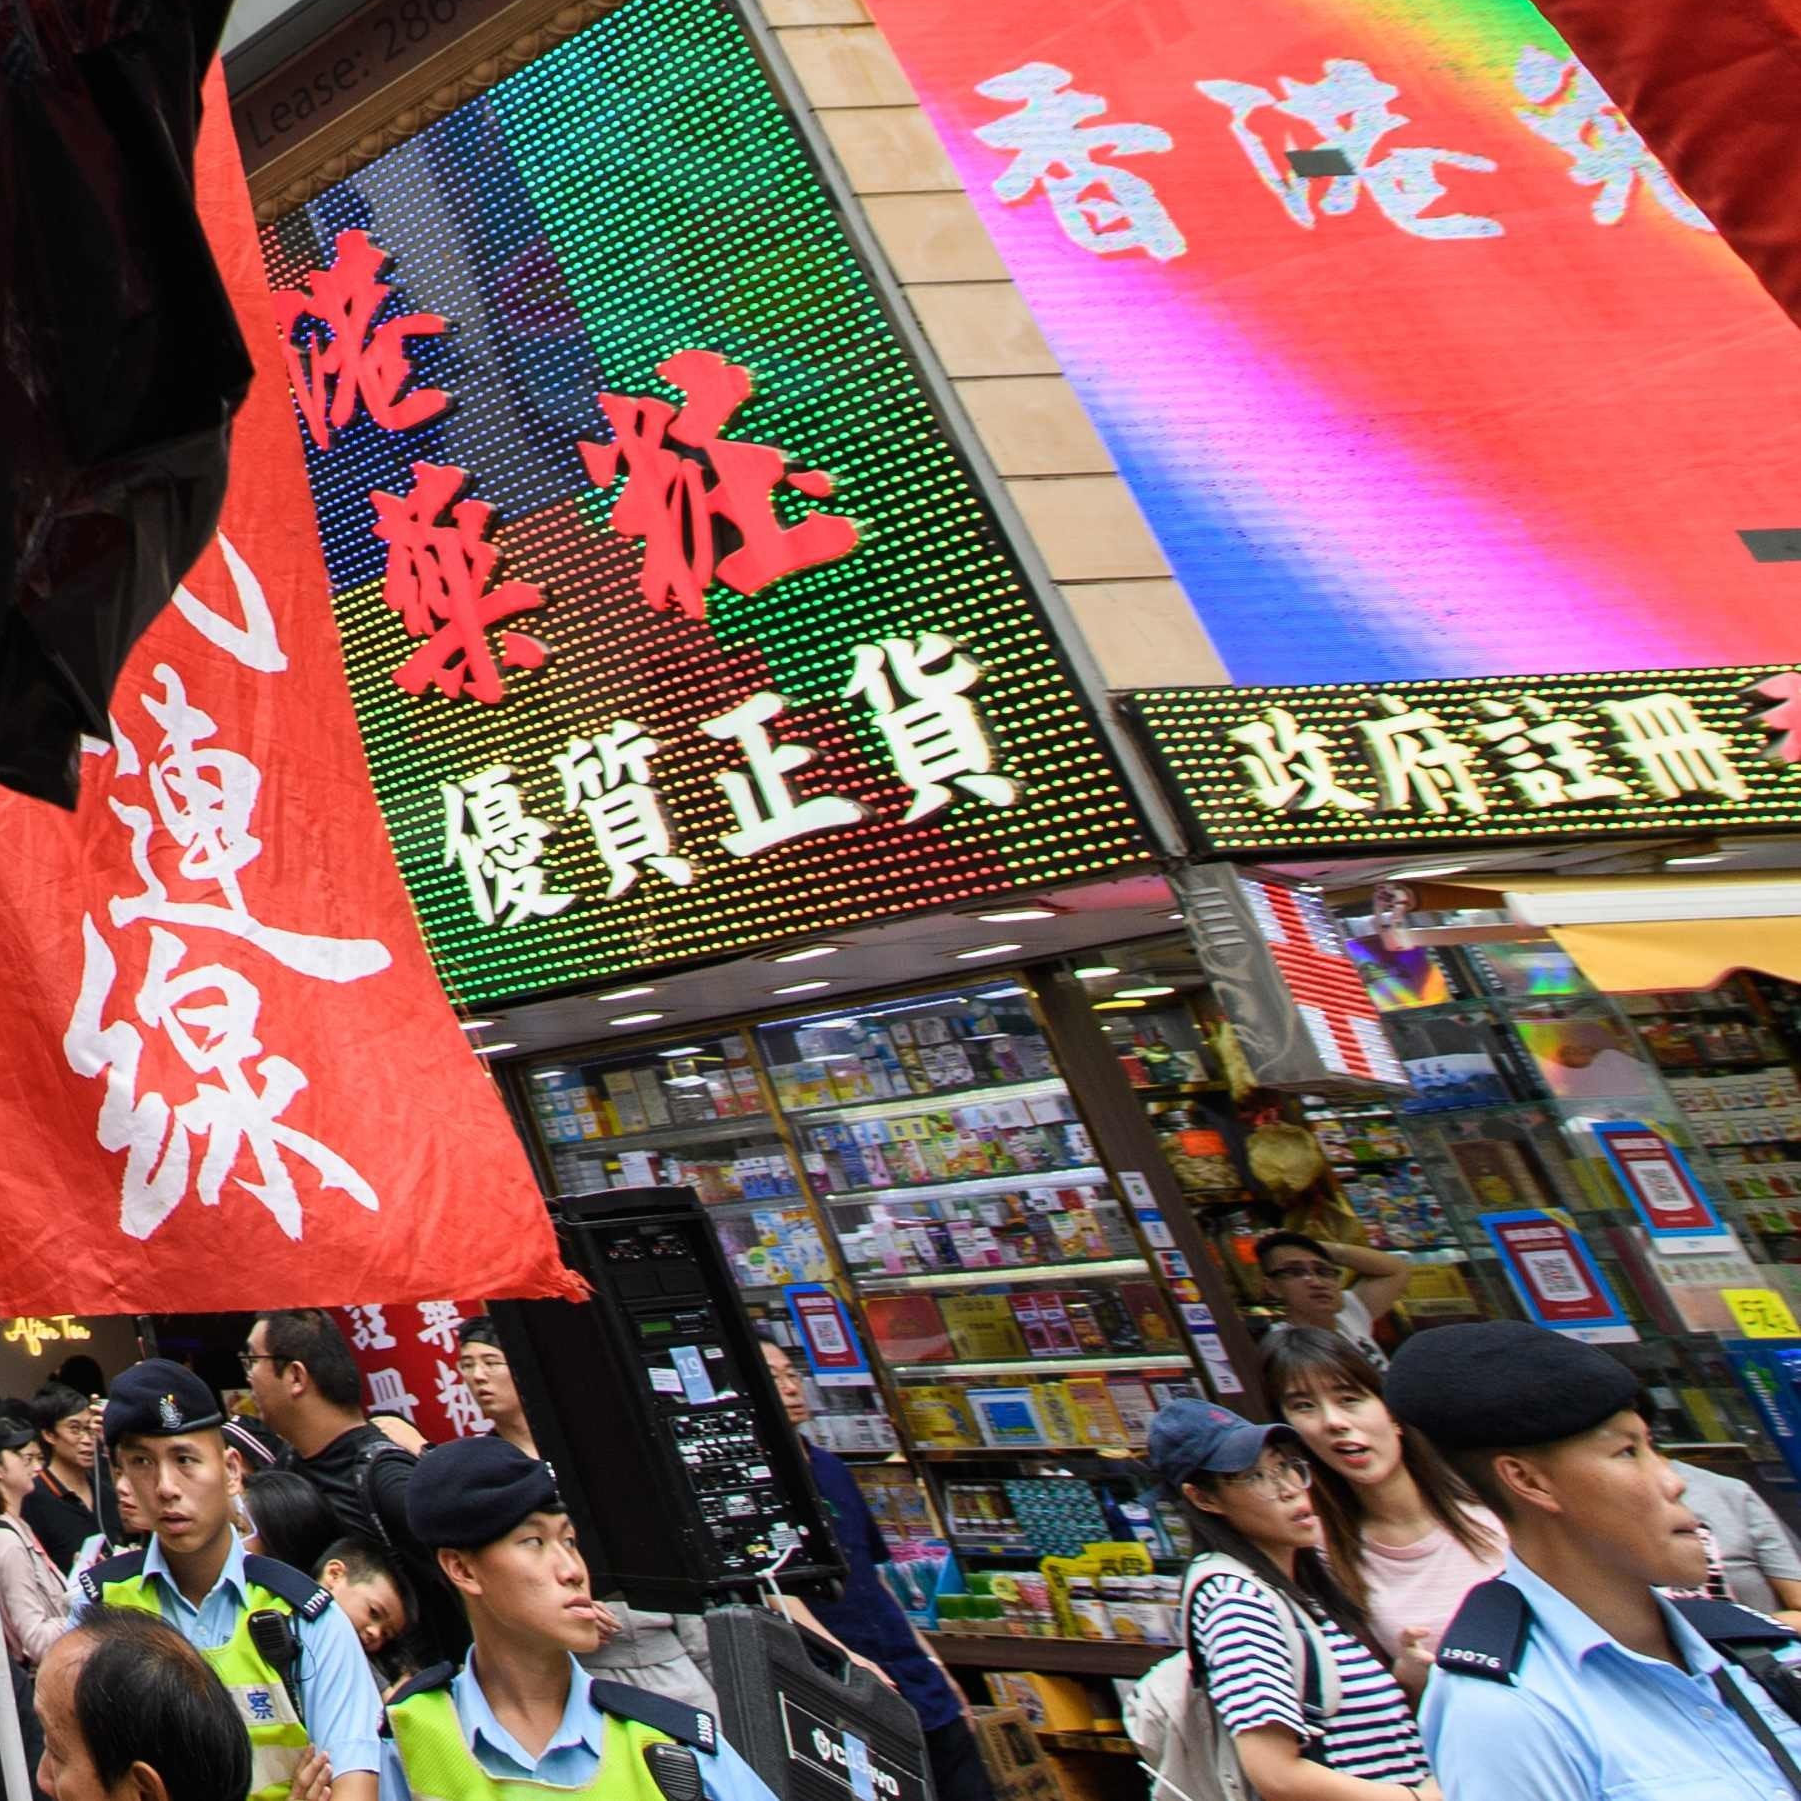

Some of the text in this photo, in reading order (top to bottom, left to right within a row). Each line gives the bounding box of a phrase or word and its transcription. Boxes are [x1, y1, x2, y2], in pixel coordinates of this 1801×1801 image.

[245, 49, 372, 150] Lease:
[442, 632, 1022, 929] 優質正貨
[1229, 694, 1747, 816] 政府註冊
[246, 1689, 274, 1720] 察
[1442, 1646, 1501, 1670] 19076
